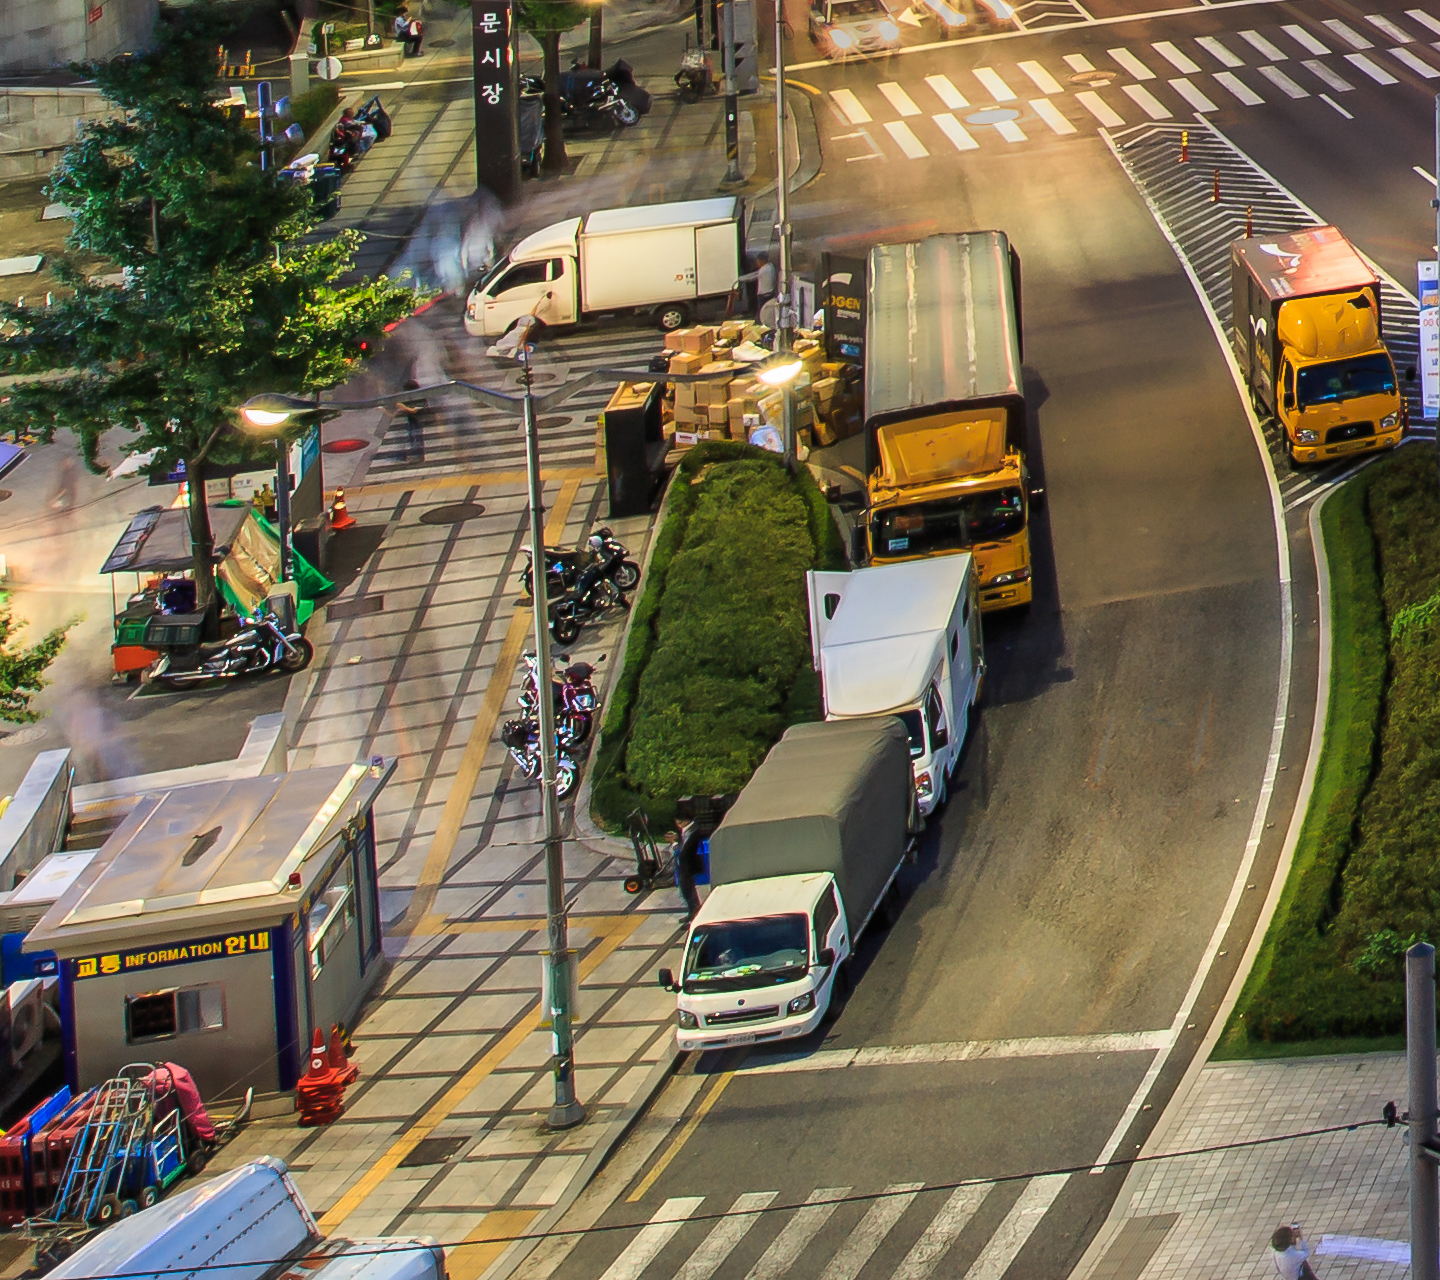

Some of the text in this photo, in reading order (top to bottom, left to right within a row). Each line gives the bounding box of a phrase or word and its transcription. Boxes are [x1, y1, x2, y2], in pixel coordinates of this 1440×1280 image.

[823, 294, 860, 309] OGEN
[77, 931, 270, 978] 교통 INFORMATION 안내
